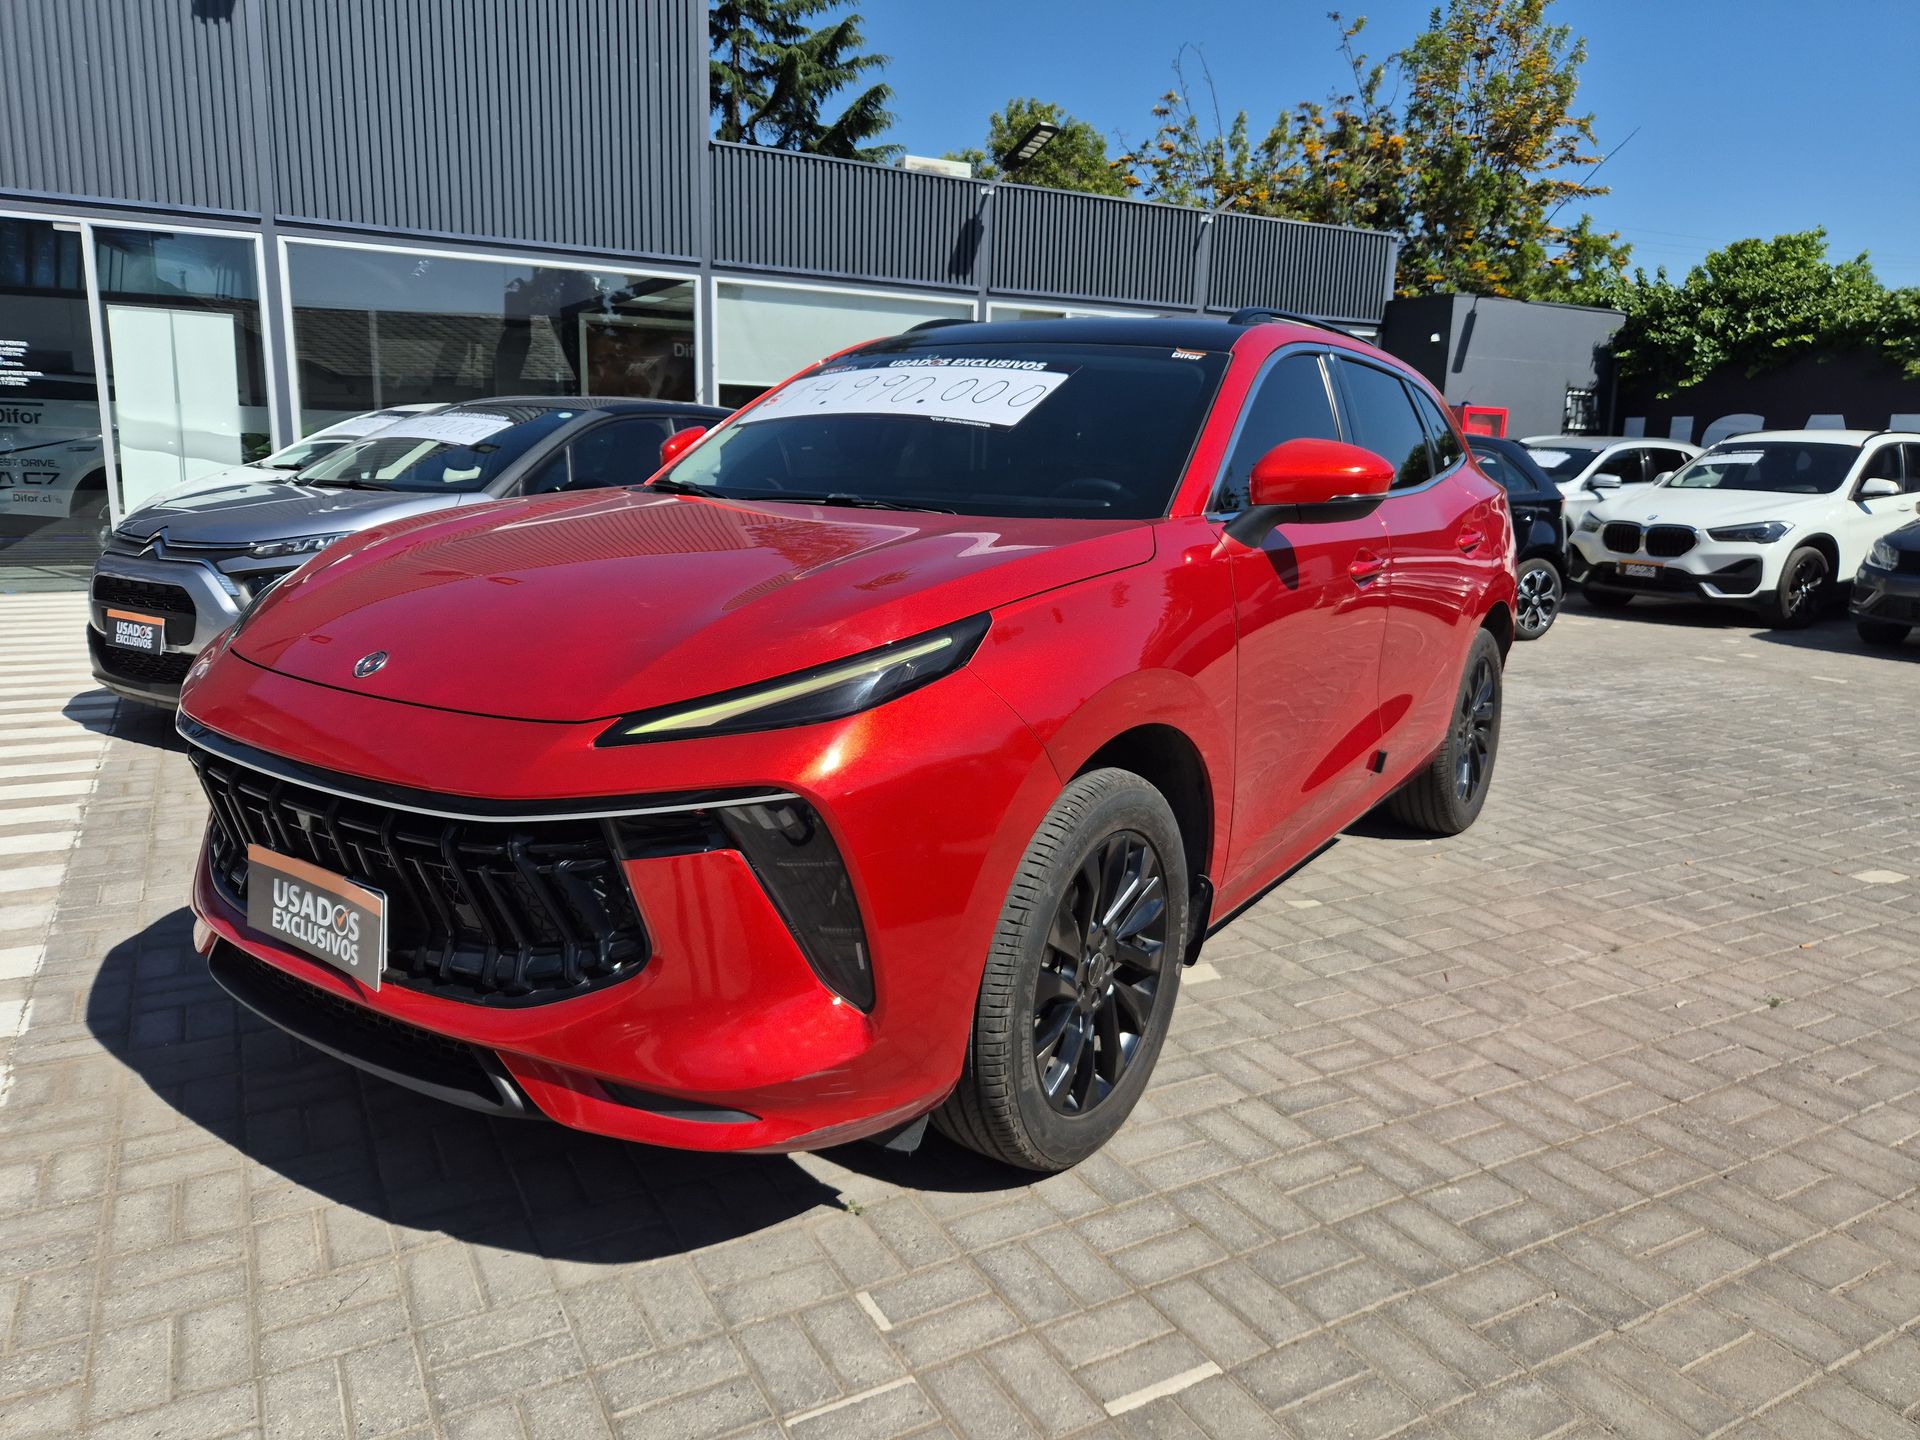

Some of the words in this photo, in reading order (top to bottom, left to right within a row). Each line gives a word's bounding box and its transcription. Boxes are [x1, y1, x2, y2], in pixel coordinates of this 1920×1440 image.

[889, 358, 952, 368] USADOS
[953, 358, 1048, 371] EXCLUSIVOS
[116, 621, 153, 639] USADOS
[115, 633, 153, 649] EXCLUSIVOS
[272, 878, 360, 942] USADOS
[271, 907, 360, 966] EXCLUSIVOS
